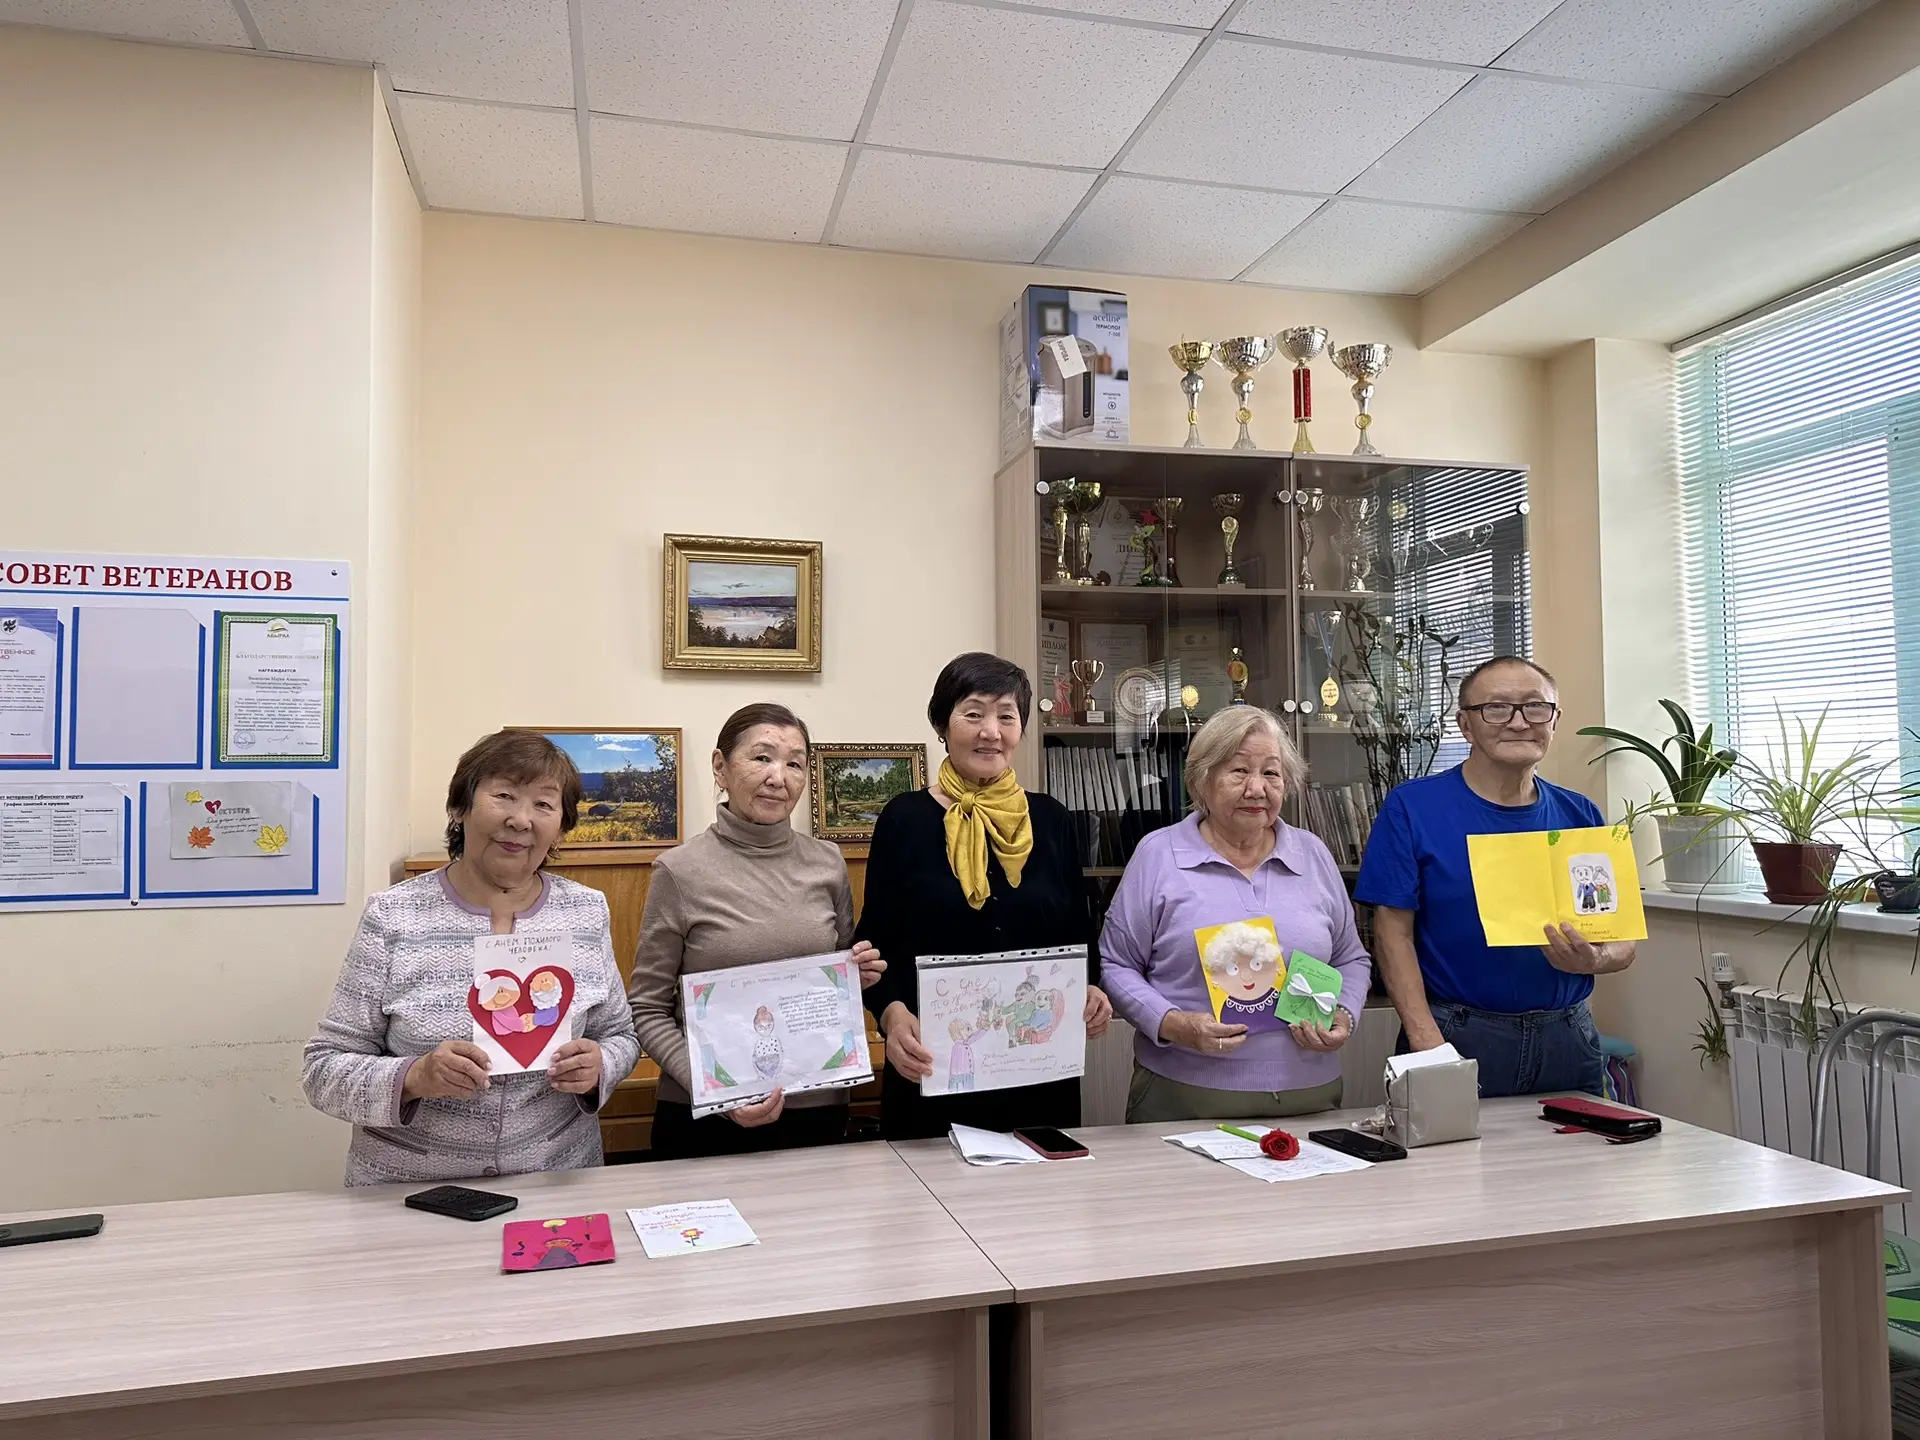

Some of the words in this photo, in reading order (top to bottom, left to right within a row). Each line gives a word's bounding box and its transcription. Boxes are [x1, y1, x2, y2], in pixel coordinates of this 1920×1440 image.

[1092, 313, 1121, 323] aceline
[1095, 323, 1121, 331] ТЕРМОПОТ
[0, 562, 95, 586] ОВЕТ
[102, 565, 293, 591] ВЕТЕРАНОВ
[485, 940, 491, 949] С
[524, 935, 562, 946] ПОЖИЛОГО
[508, 945, 552, 955] ЧЕЛОВЕКА!
[935, 978, 949, 997] С
